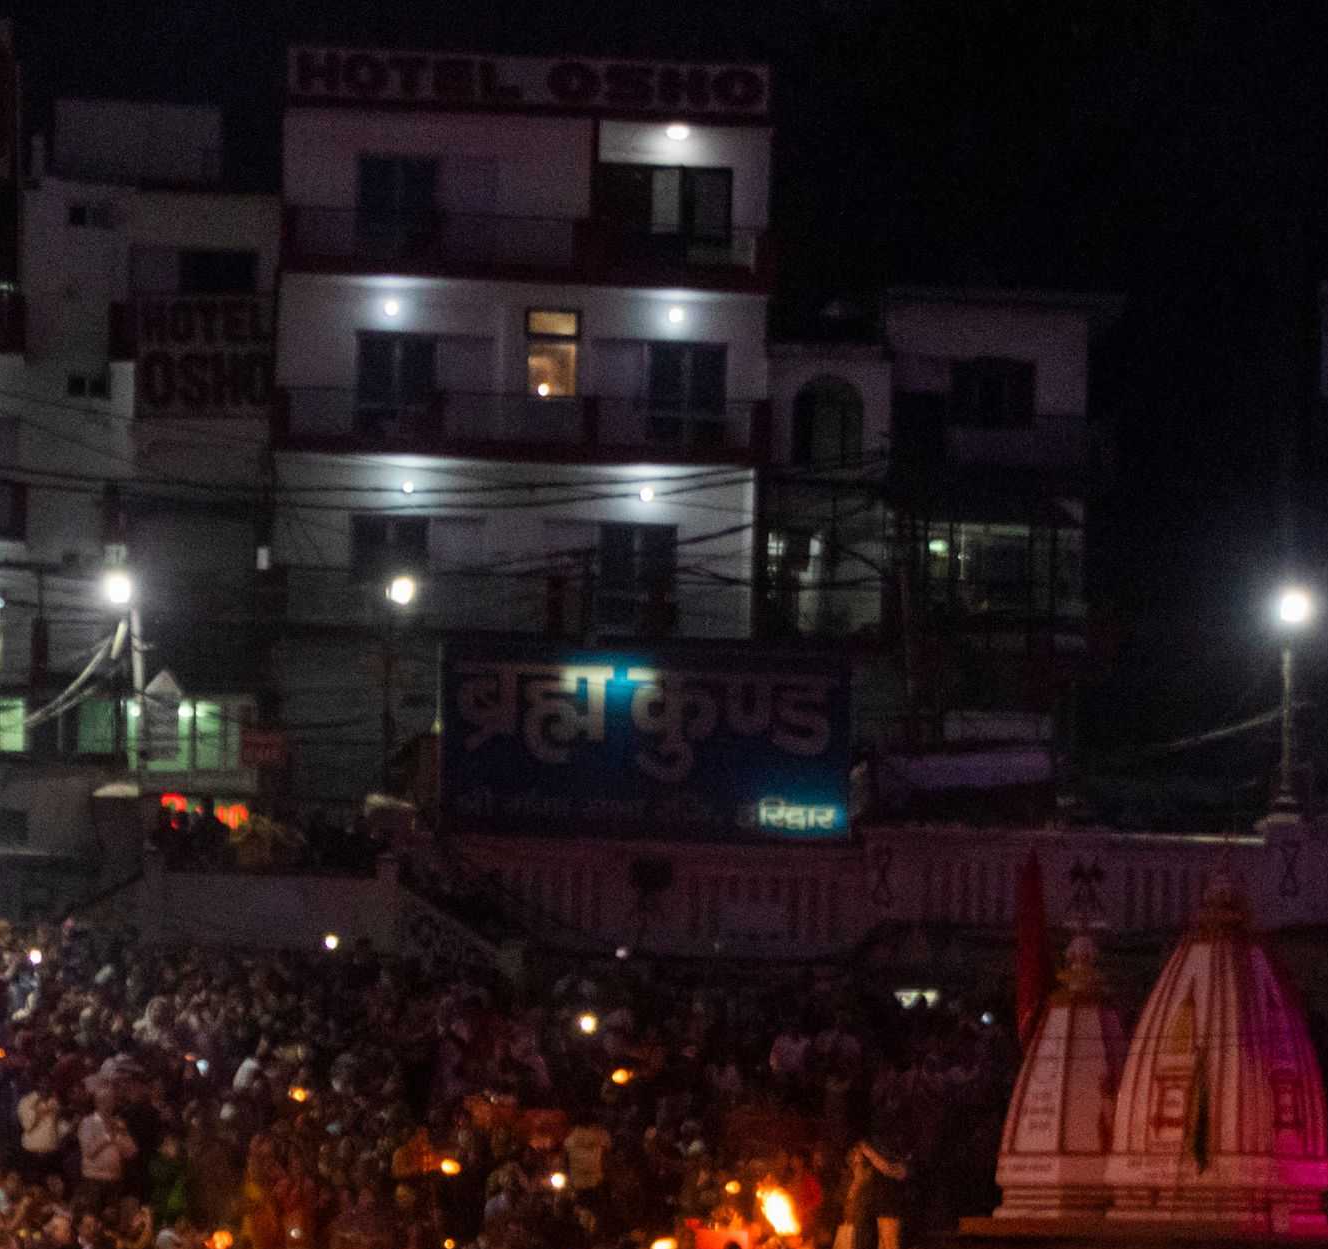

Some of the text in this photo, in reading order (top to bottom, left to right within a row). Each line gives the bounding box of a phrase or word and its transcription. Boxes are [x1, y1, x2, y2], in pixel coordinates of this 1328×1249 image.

[297, 53, 763, 108] HOTEL OSHO
[140, 300, 273, 344] HOTEL
[143, 351, 273, 409] OSHO
